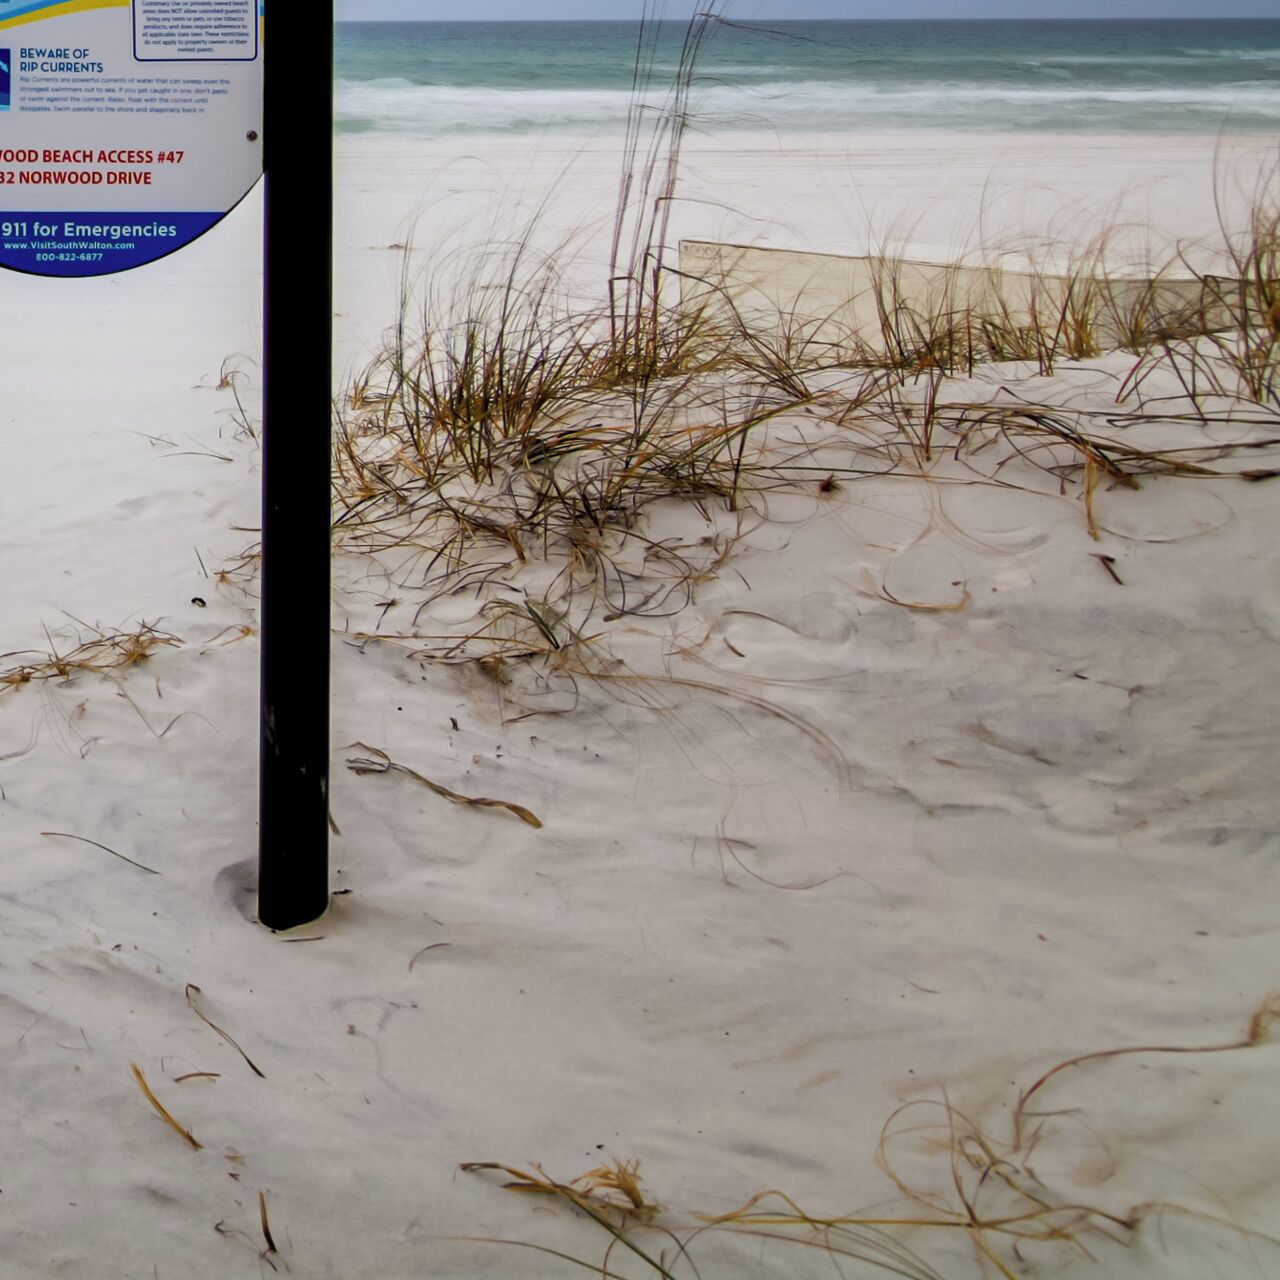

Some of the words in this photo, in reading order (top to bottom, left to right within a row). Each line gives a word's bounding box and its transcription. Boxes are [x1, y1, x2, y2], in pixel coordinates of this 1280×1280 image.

[20, 48, 70, 59] BEWARE
[72, 48, 90, 59] OF
[20, 62, 38, 72] RIP
[40, 62, 104, 73] CURRENTS
[42, 150, 94, 163] BEACH
[97, 150, 154, 164] ACCESS
[157, 150, 184, 164] #47
[19, 171, 102, 185] NORWOOD
[107, 172, 152, 185] DRIVE
[2, 222, 28, 237] 911
[34, 222, 58, 237] for
[64, 222, 177, 239] Emergencies
[4, 241, 135, 250] www.VisitSouthWalton.com
[36, 253, 104, 262] 800-822-6877
